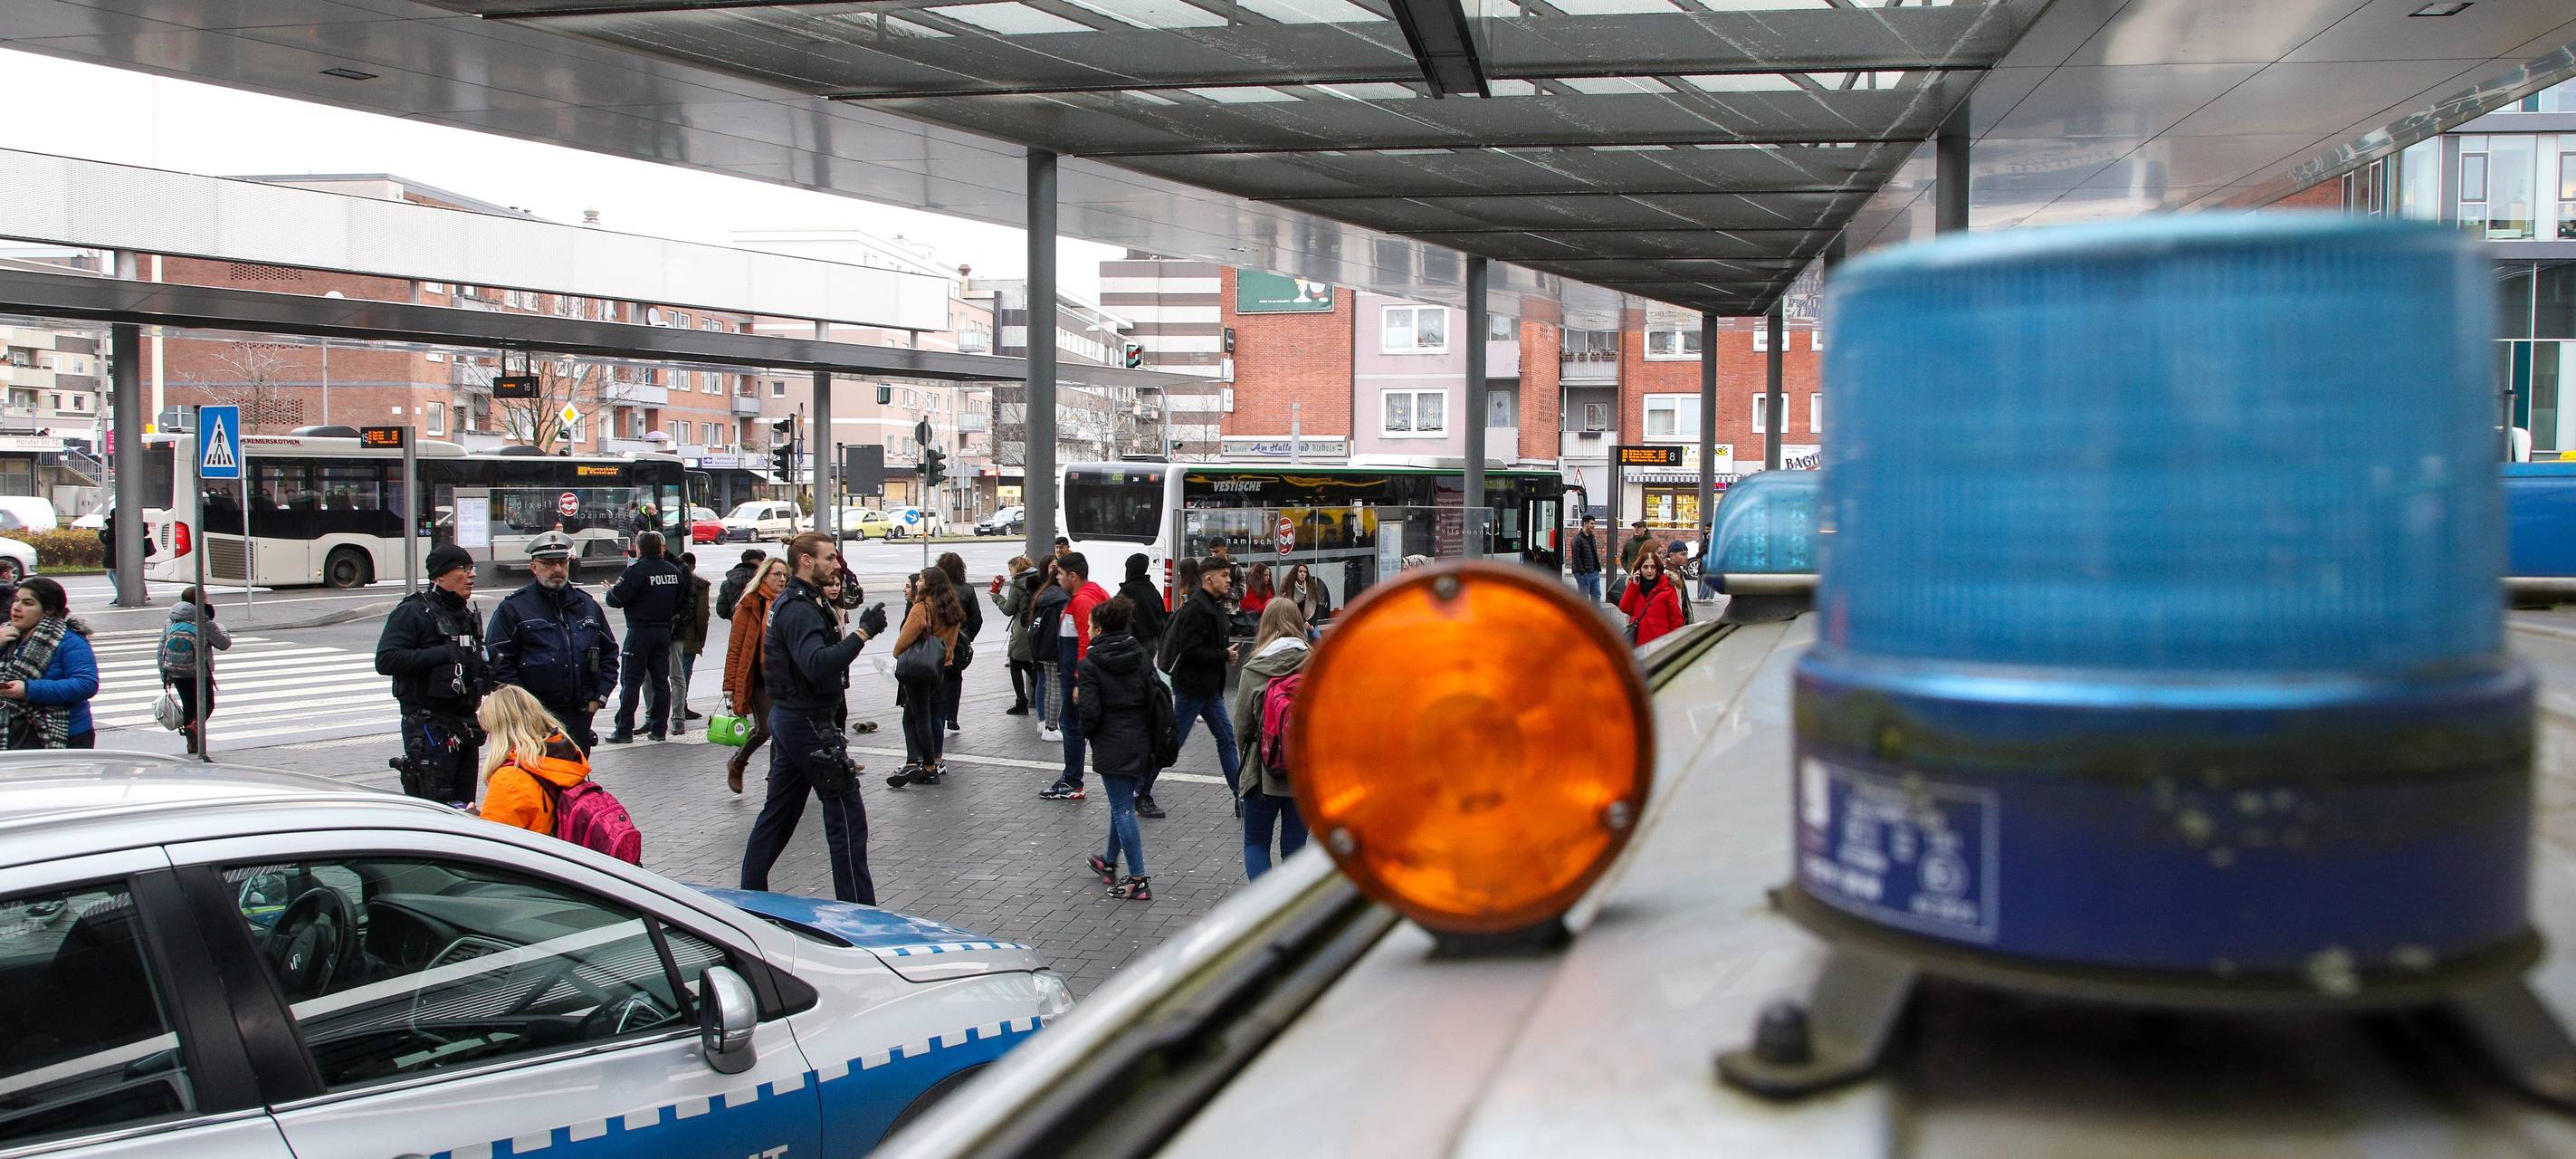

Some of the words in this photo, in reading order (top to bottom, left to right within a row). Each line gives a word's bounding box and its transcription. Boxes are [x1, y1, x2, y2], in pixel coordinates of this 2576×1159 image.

[523, 383, 531, 391] 16
[362, 433, 368, 443] 15
[1669, 452, 1675, 461] 8
[1213, 481, 1261, 492] VESTISCHE
[650, 575, 678, 586] POLIZEI
